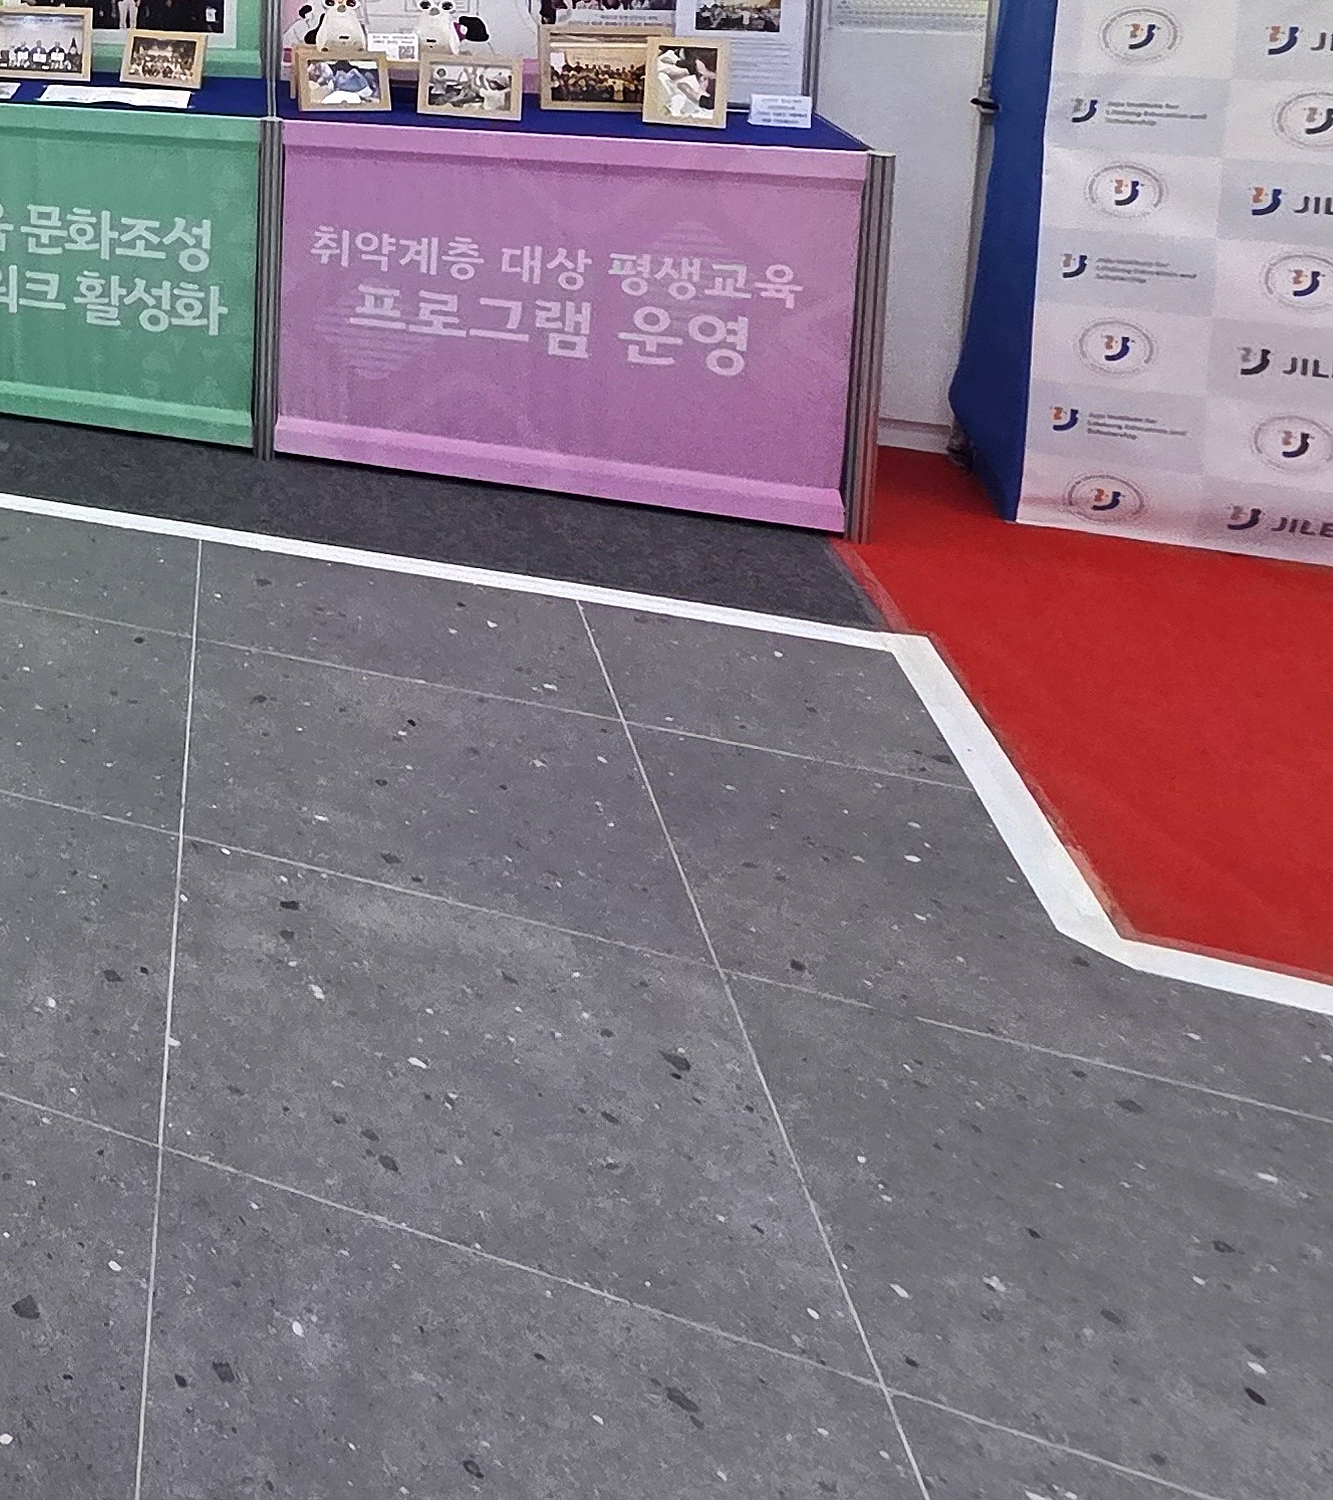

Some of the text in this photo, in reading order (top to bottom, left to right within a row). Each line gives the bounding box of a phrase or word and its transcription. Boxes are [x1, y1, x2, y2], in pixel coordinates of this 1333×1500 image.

[19, 203, 213, 274] 문화조성
[309, 223, 806, 312] 취약계층 대상 평생교육
[73, 269, 230, 339] 활성화
[348, 287, 751, 378] 프로그램 운영
